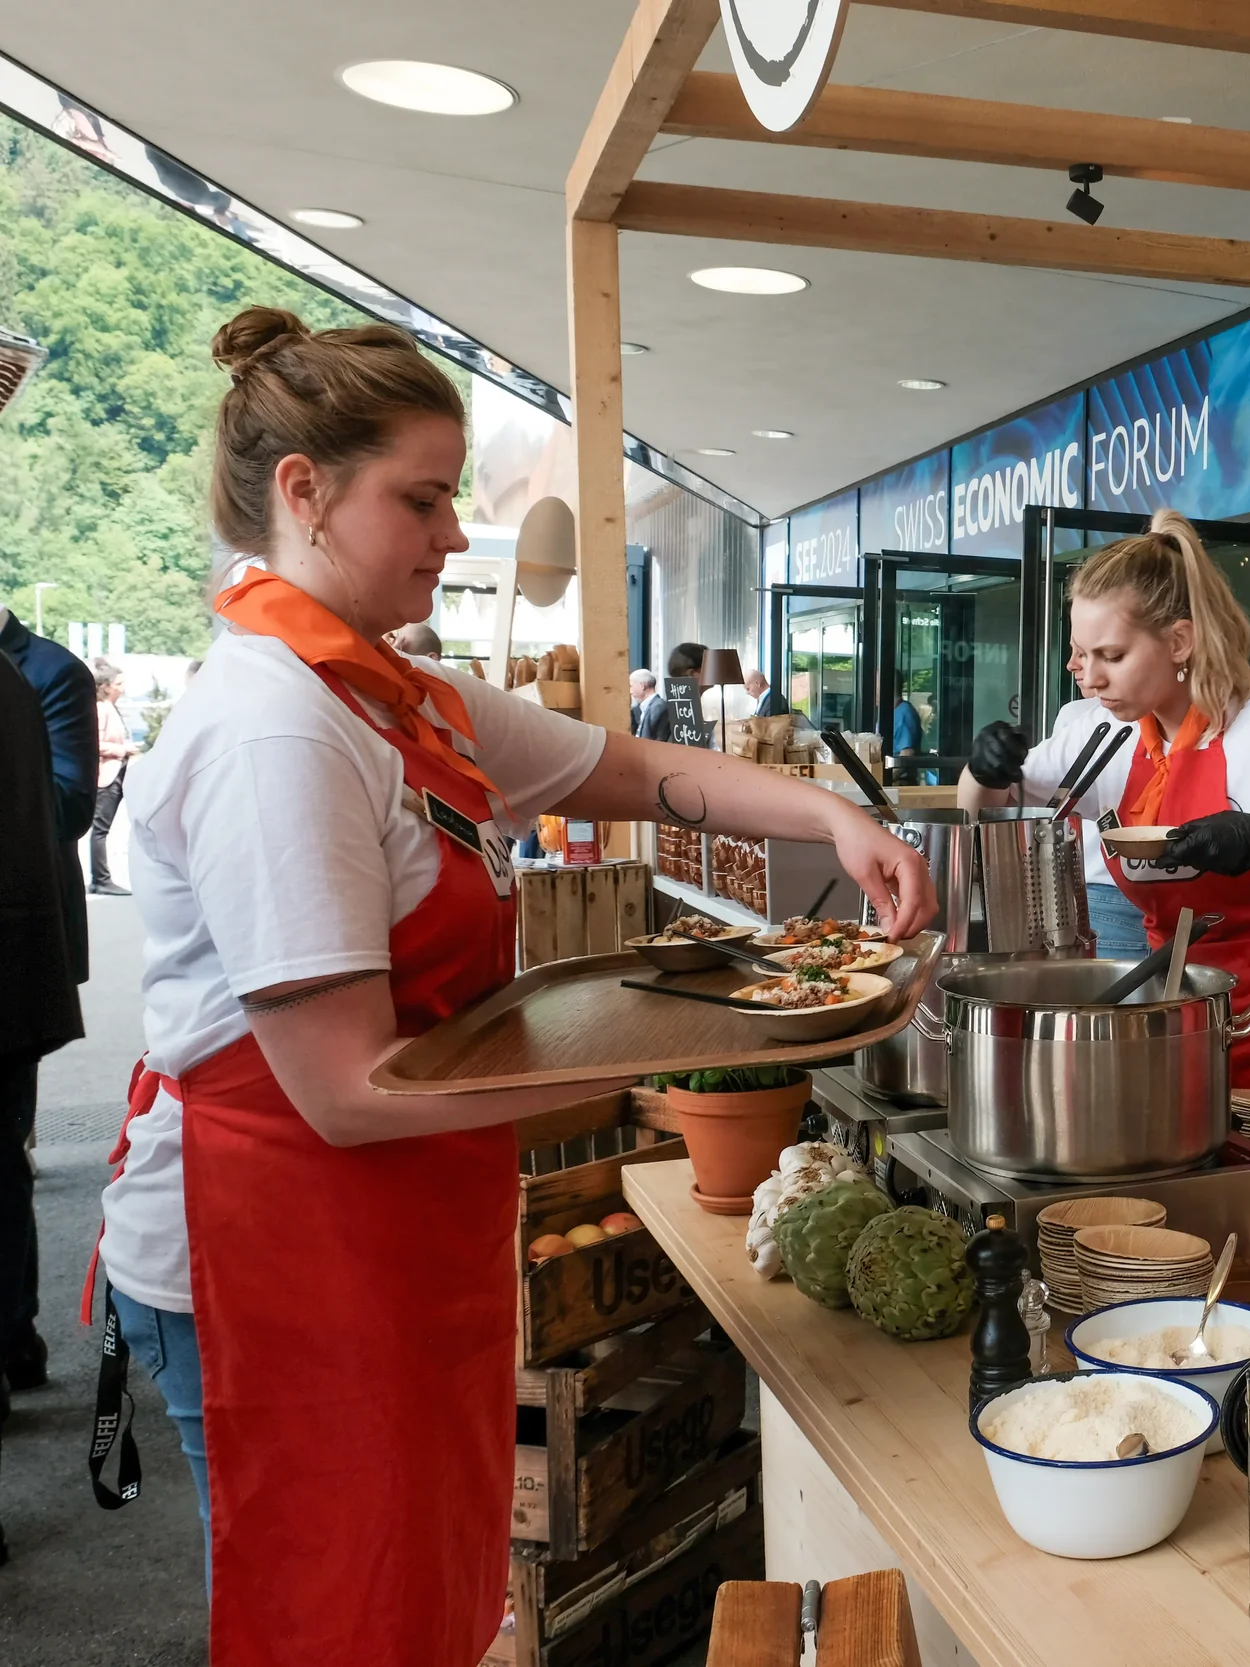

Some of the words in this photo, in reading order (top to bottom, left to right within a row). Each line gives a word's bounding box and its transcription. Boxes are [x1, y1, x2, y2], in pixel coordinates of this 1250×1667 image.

[894, 490, 946, 552] SWISS
[953, 442, 1079, 540] ECONOMIC
[1091, 395, 1209, 502] FORUM
[795, 525, 851, 583] SEF.2024
[593, 1250, 692, 1316] Use
[103, 1313, 117, 1357] FELFEL
[92, 1412, 118, 1459] FELFEL
